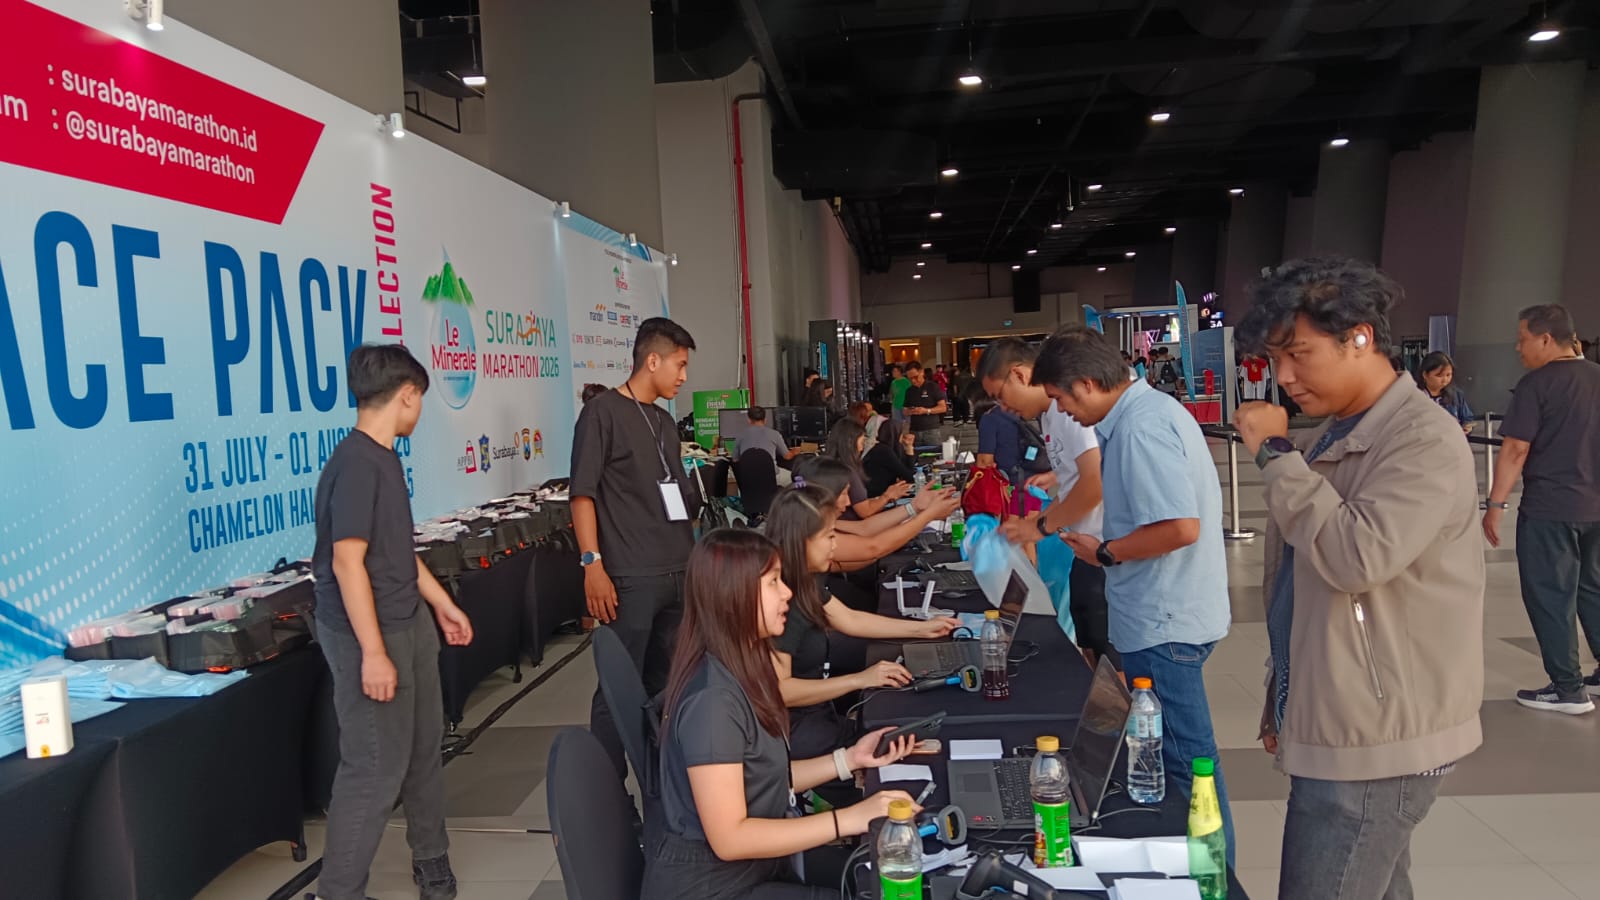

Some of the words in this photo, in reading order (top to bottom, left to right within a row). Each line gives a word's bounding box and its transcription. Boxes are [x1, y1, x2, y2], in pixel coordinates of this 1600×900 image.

[61, 68, 258, 153] surabayamarathon.id
[66, 111, 255, 185] @surabayamarathon
[370, 183, 404, 346] LECTION
[431, 344, 477, 371] Minerale
[445, 319, 460, 347] Le
[483, 353, 539, 379] MARATHON
[540, 356, 560, 378] 2026
[183, 441, 214, 493] 31
[221, 435, 268, 487] JULY
[289, 431, 312, 475] 01
[188, 492, 285, 553] CHAMELON
